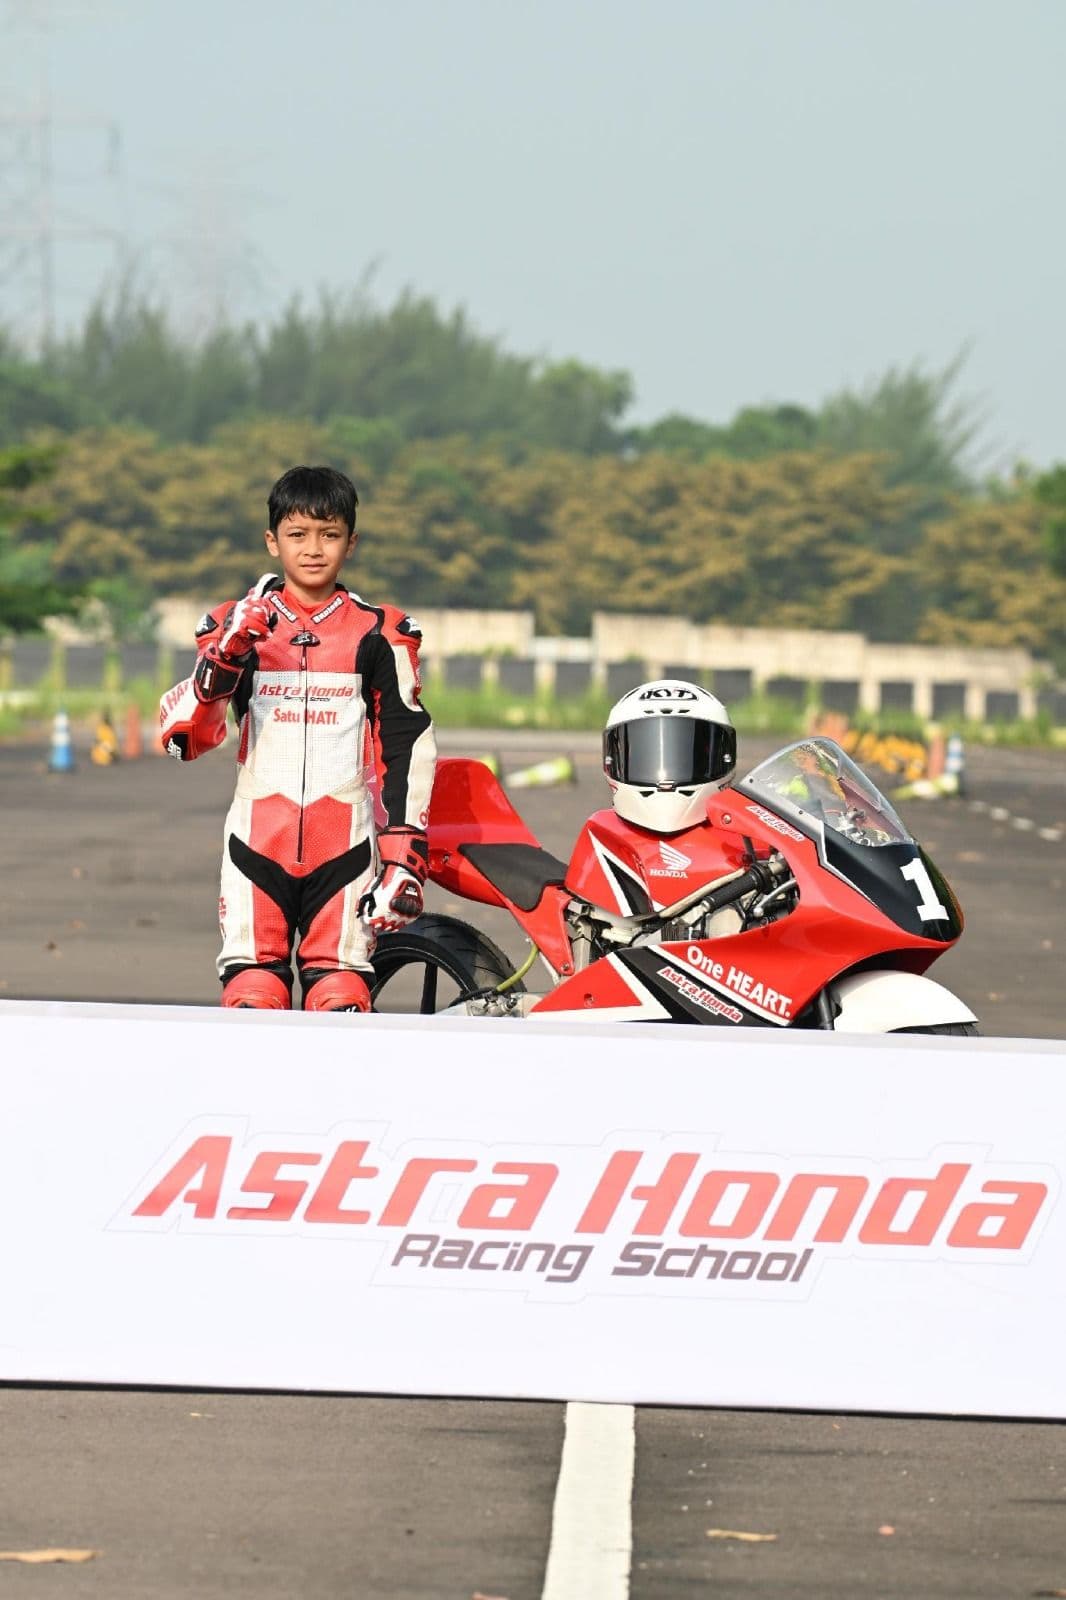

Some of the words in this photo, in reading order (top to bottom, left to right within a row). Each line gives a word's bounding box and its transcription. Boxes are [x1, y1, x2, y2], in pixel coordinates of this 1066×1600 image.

[259, 684, 302, 696] Astra
[305, 686, 354, 697] Honda
[273, 707, 300, 723] Satu
[646, 688, 691, 699] KYT
[649, 868, 689, 879] HONDA
[900, 858, 949, 921] 1
[661, 967, 699, 995] Astra
[698, 990, 742, 1021] Honda
[687, 945, 724, 979] One
[725, 965, 793, 1018] HEART.
[131, 1135, 559, 1231] Astra
[574, 1150, 1048, 1249] Honda
[391, 1233, 594, 1283] Racing
[611, 1241, 814, 1282] School
